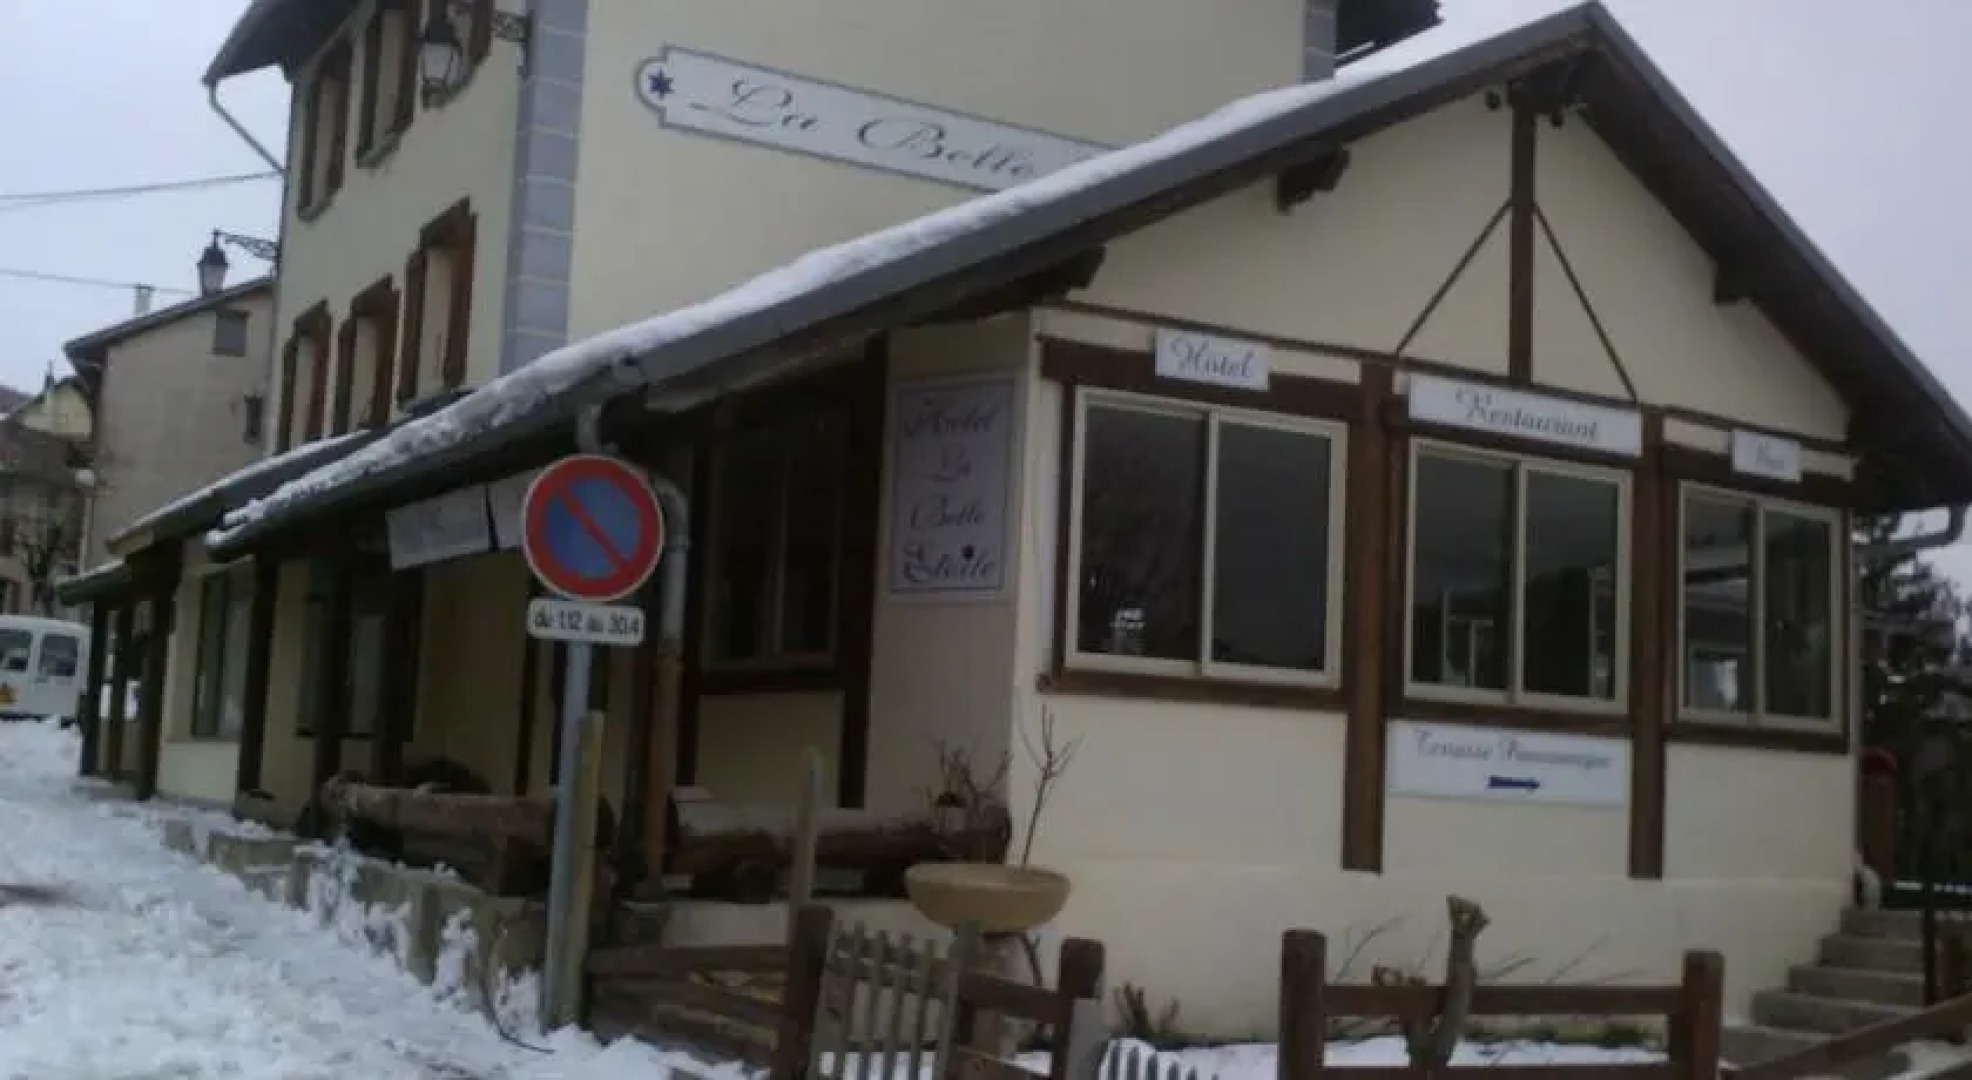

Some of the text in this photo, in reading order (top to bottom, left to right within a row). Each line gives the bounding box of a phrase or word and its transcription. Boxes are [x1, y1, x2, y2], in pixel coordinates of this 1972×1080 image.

[687, 75, 1034, 177] La Belle
[1455, 386, 1598, 440] Restaurant
